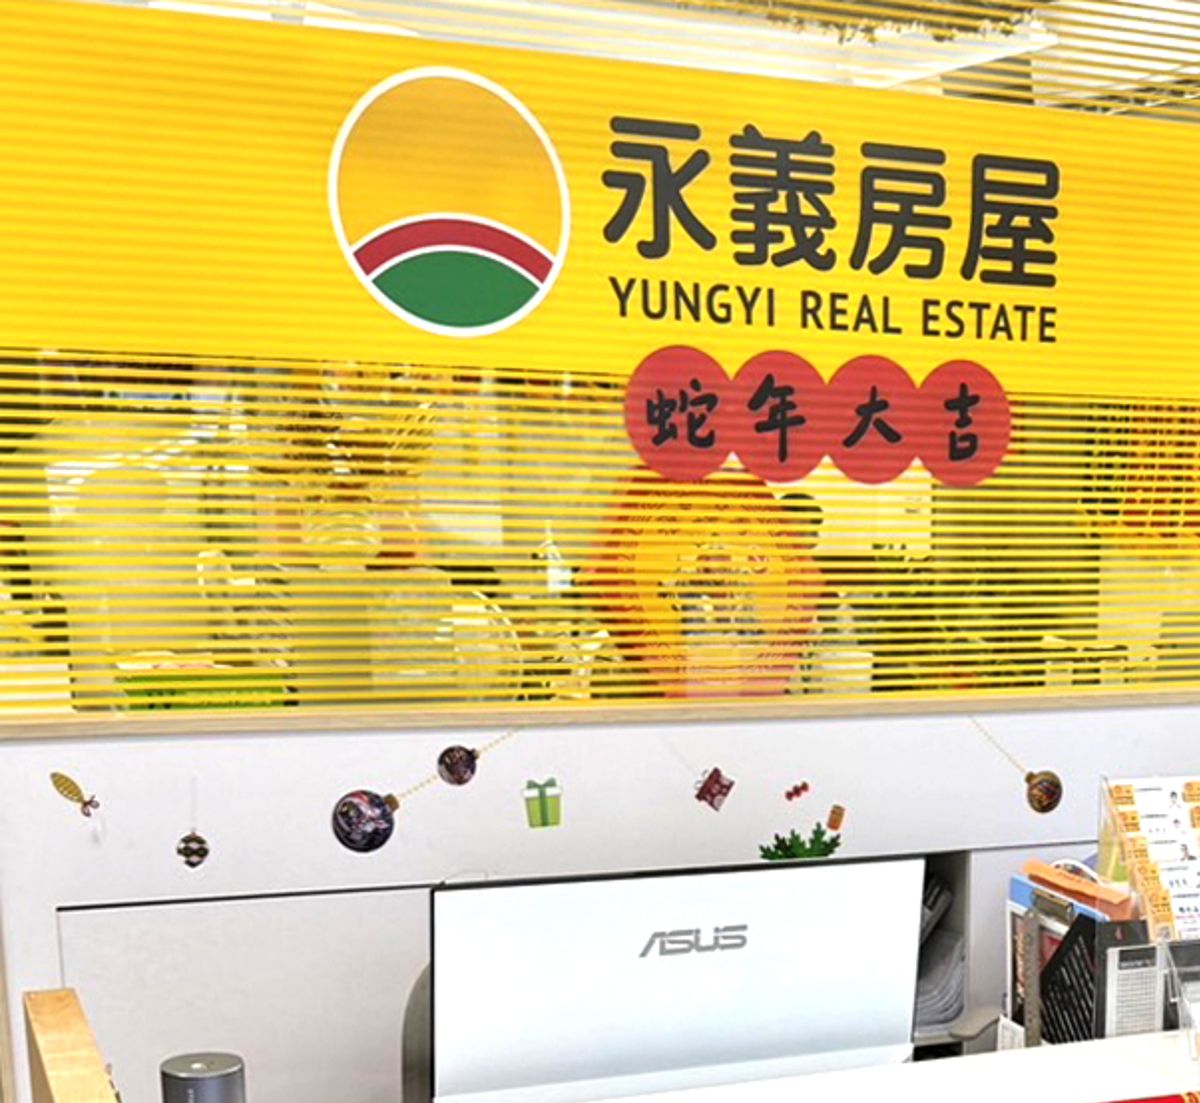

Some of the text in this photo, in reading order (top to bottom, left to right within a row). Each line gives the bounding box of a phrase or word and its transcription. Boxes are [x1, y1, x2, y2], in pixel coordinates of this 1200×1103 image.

[601, 117, 1060, 288] 永義房屋
[609, 276, 1057, 344] YUNGYI REAL ESTATE
[644, 372, 981, 465] 蛇年大吉
[639, 925, 748, 958] ASUS
